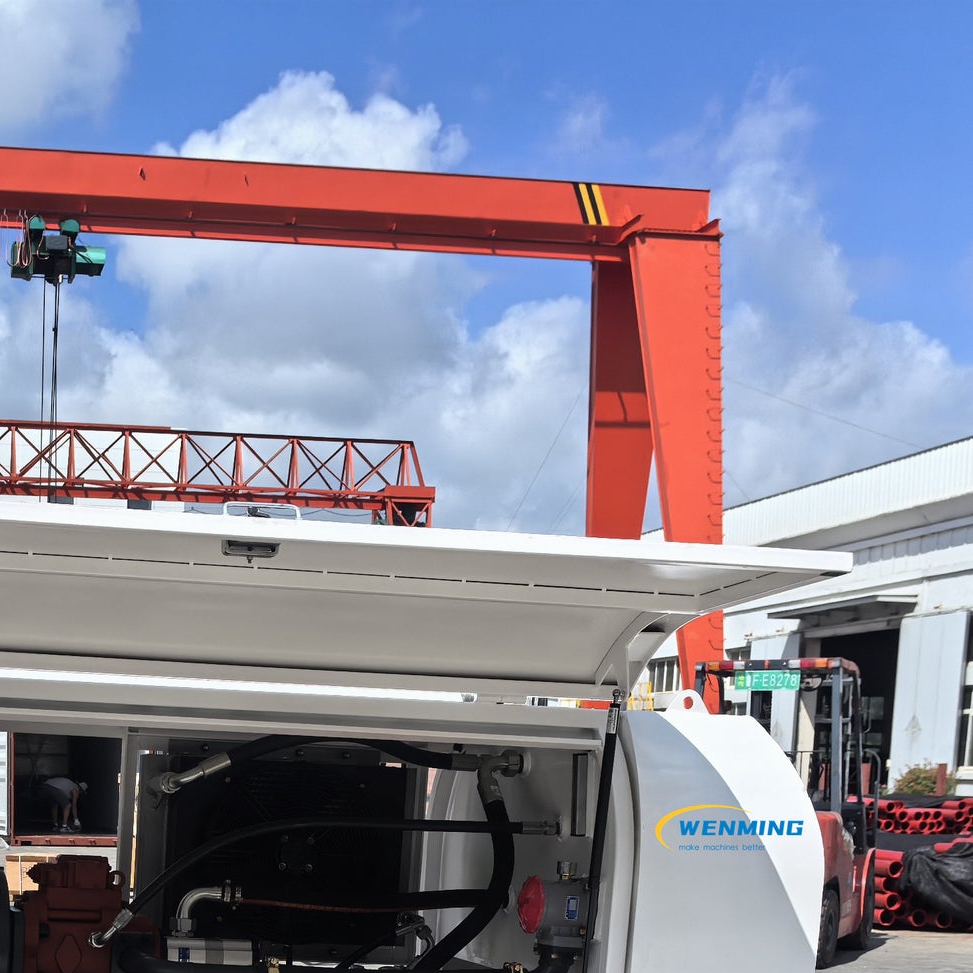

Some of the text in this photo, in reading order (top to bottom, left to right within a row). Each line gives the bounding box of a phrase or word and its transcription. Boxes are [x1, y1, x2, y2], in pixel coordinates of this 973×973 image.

[679, 820, 804, 836] WENMING
[679, 843, 699, 851] make
[703, 843, 738, 851] machines
